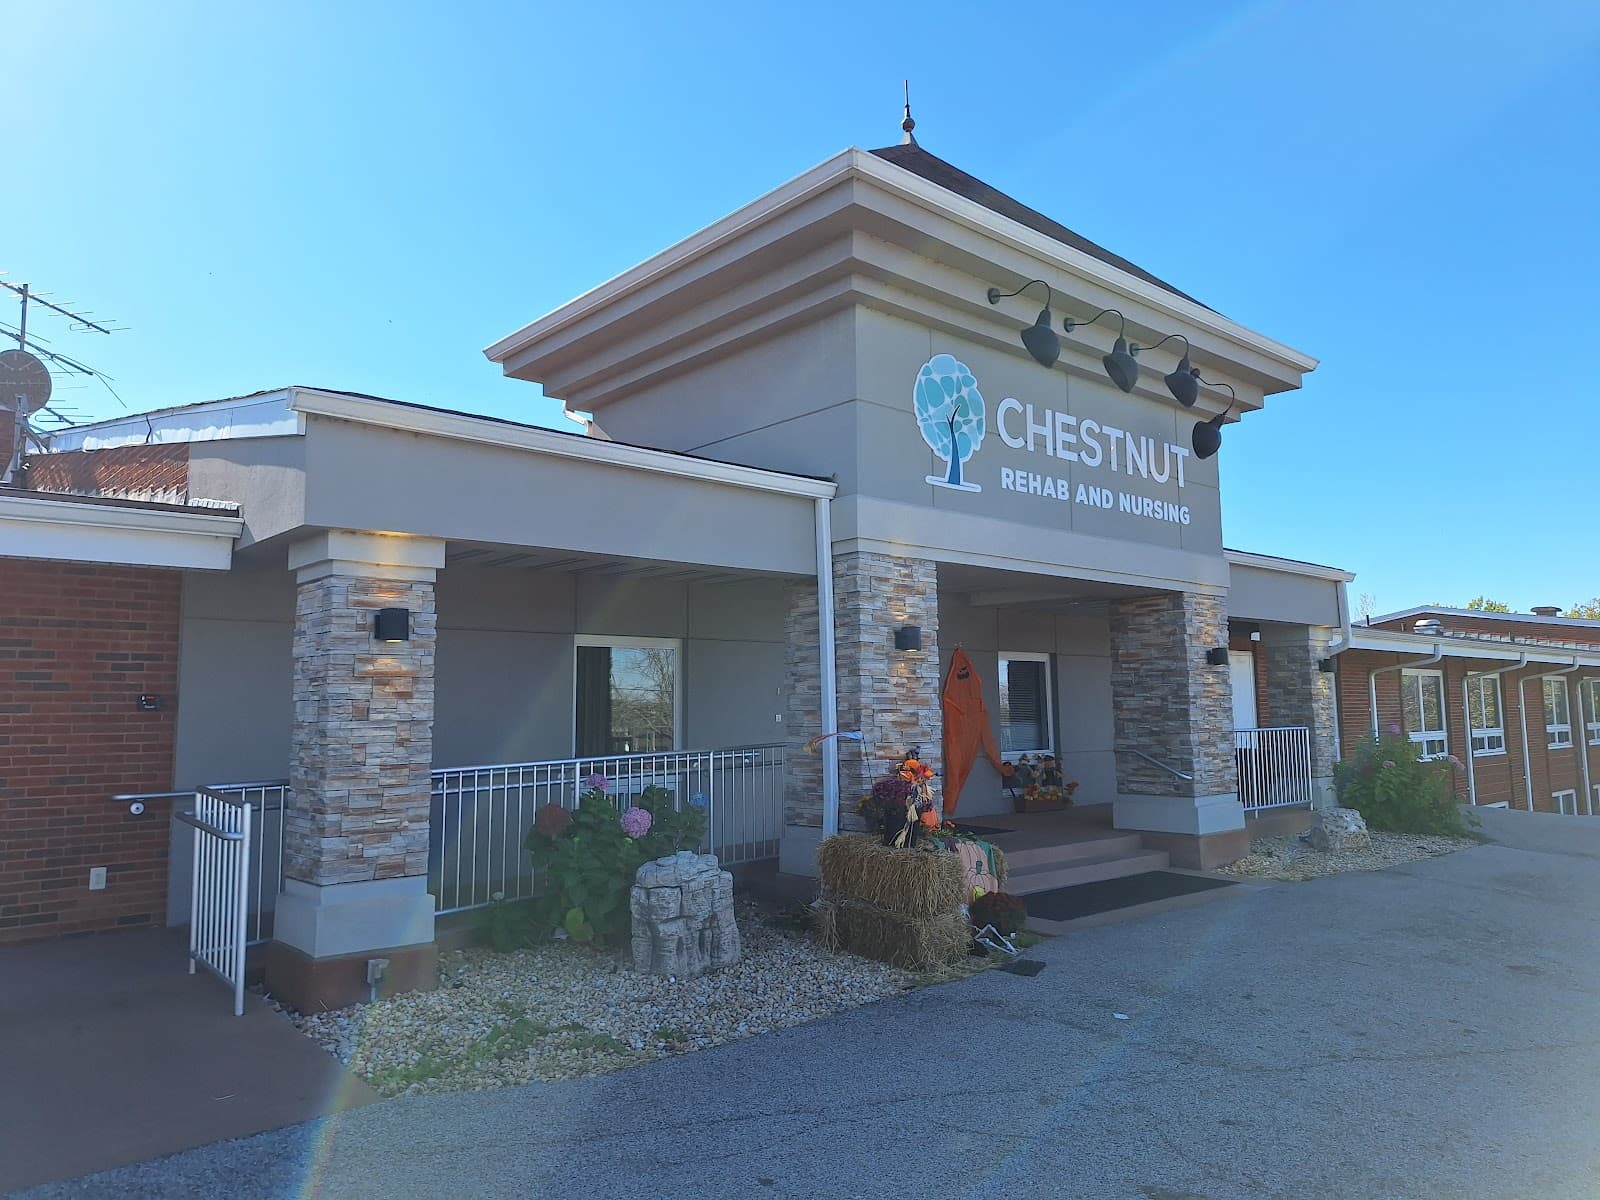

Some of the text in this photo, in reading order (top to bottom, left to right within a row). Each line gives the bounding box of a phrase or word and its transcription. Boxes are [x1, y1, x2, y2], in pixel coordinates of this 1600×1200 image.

[996, 397, 1190, 488] CHESTNUT
[1001, 467, 1191, 526] REHAB AND NURSING
